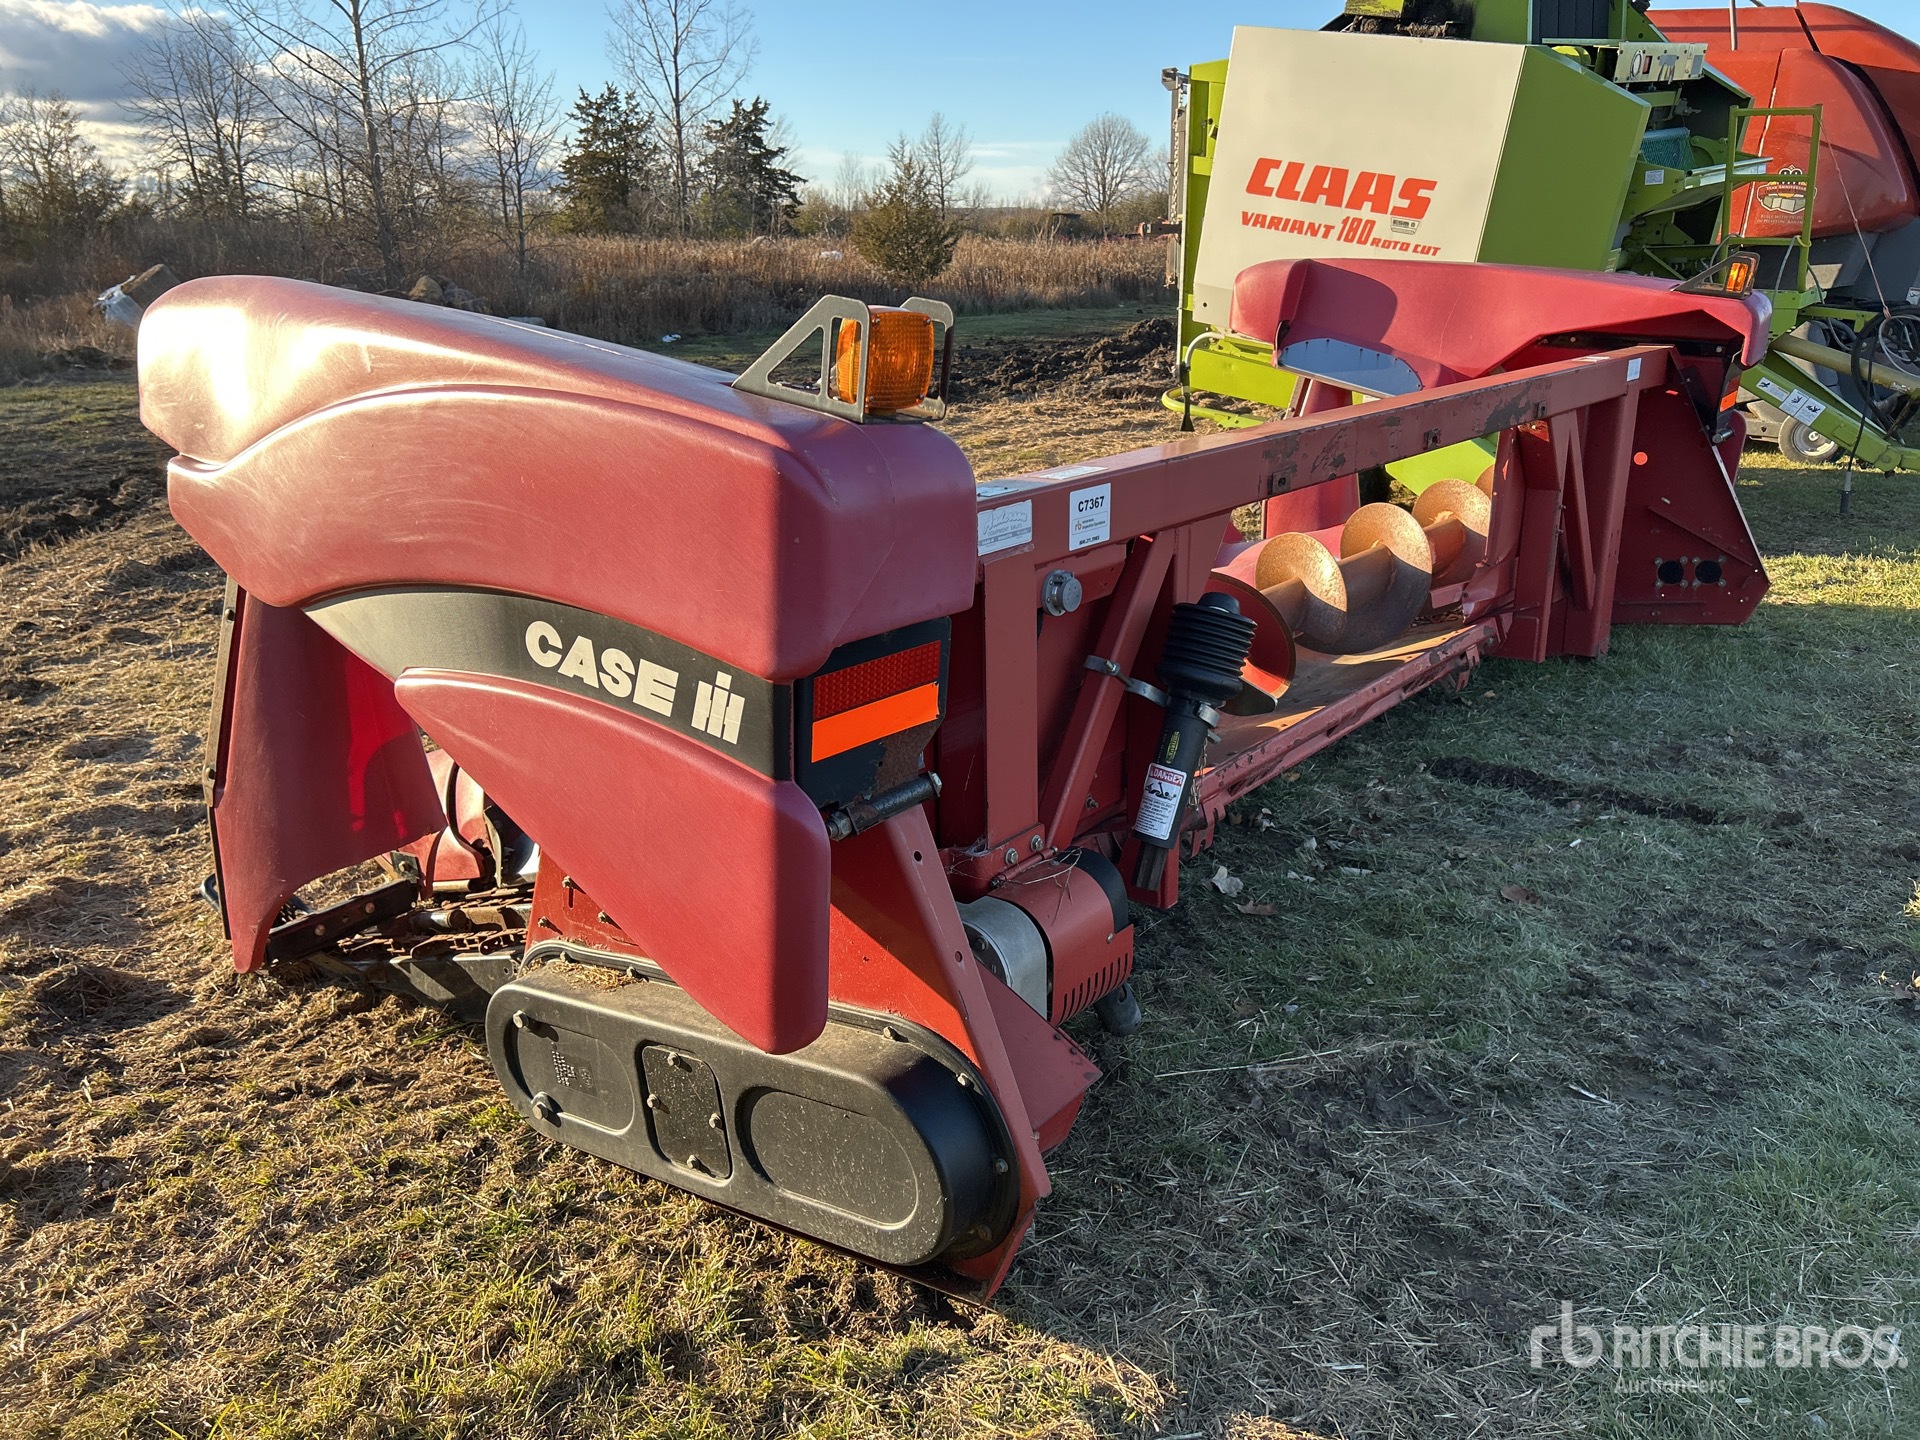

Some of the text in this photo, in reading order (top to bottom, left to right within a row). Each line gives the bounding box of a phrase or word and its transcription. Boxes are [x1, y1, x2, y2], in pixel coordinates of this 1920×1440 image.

[1245, 157, 1438, 219] CLAAS
[1241, 210, 1376, 245] VARIANT 180
[1370, 237, 1442, 256] ROTO CUT
[1078, 496, 1105, 512] C7367
[525, 620, 679, 717] CASE
[1153, 768, 1183, 784] DANGER
